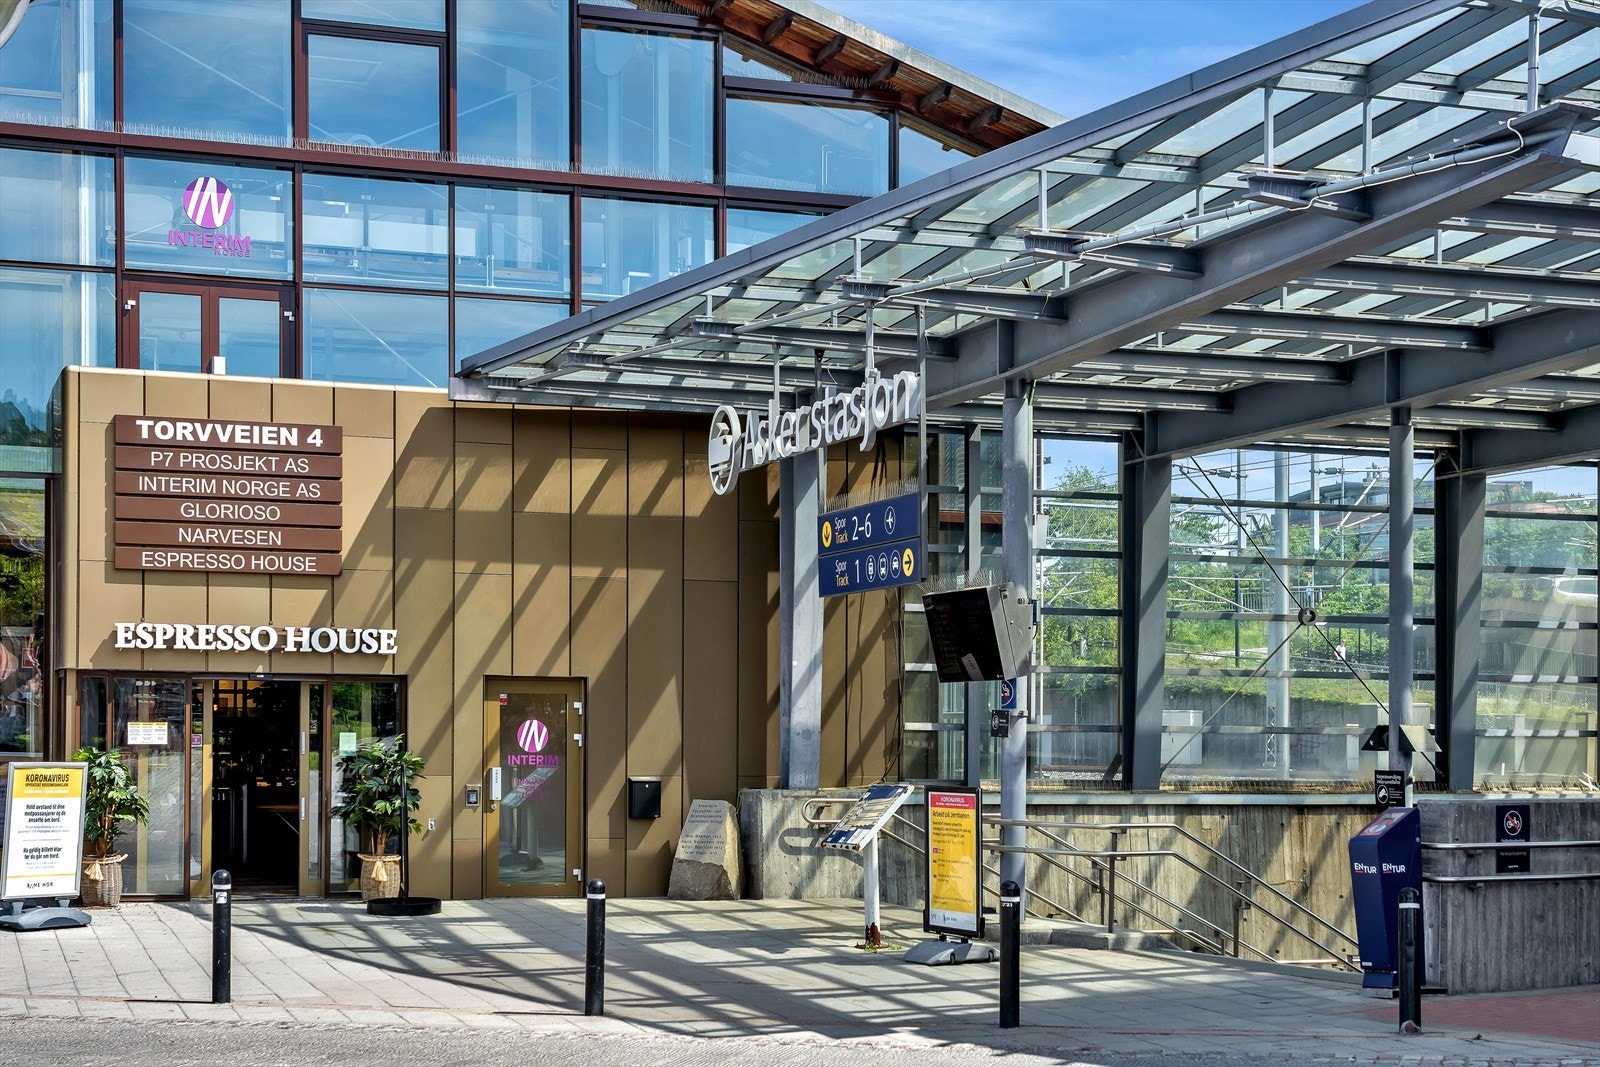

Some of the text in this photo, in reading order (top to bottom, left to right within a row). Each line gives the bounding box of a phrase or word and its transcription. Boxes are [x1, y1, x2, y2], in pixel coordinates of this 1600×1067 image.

[168, 230, 251, 250] INTERIM
[214, 248, 250, 258] NORGE
[742, 371, 921, 469] Asker stasjon
[136, 420, 324, 447] TORVVEIEN 4
[150, 452, 309, 473] P7 PROSJEKT AS
[138, 476, 320, 498] INTERIM NORGE AS
[180, 502, 281, 520] GLORIOSO
[834, 516, 846, 530] Spor
[178, 528, 282, 546] NARVESEN
[835, 530, 848, 544] Track
[142, 552, 317, 571] ESPRESSO HOUSE
[835, 560, 847, 574] Spor
[836, 573, 849, 587] Track
[854, 559, 860, 584] 1
[114, 622, 398, 654] ESPRESSO HOUSE
[507, 754, 558, 766] INTERIM
[26, 774, 70, 782] KORONAVIRUS
[1354, 862, 1377, 874] ENTUR
[1382, 863, 1406, 873] ENTUR
